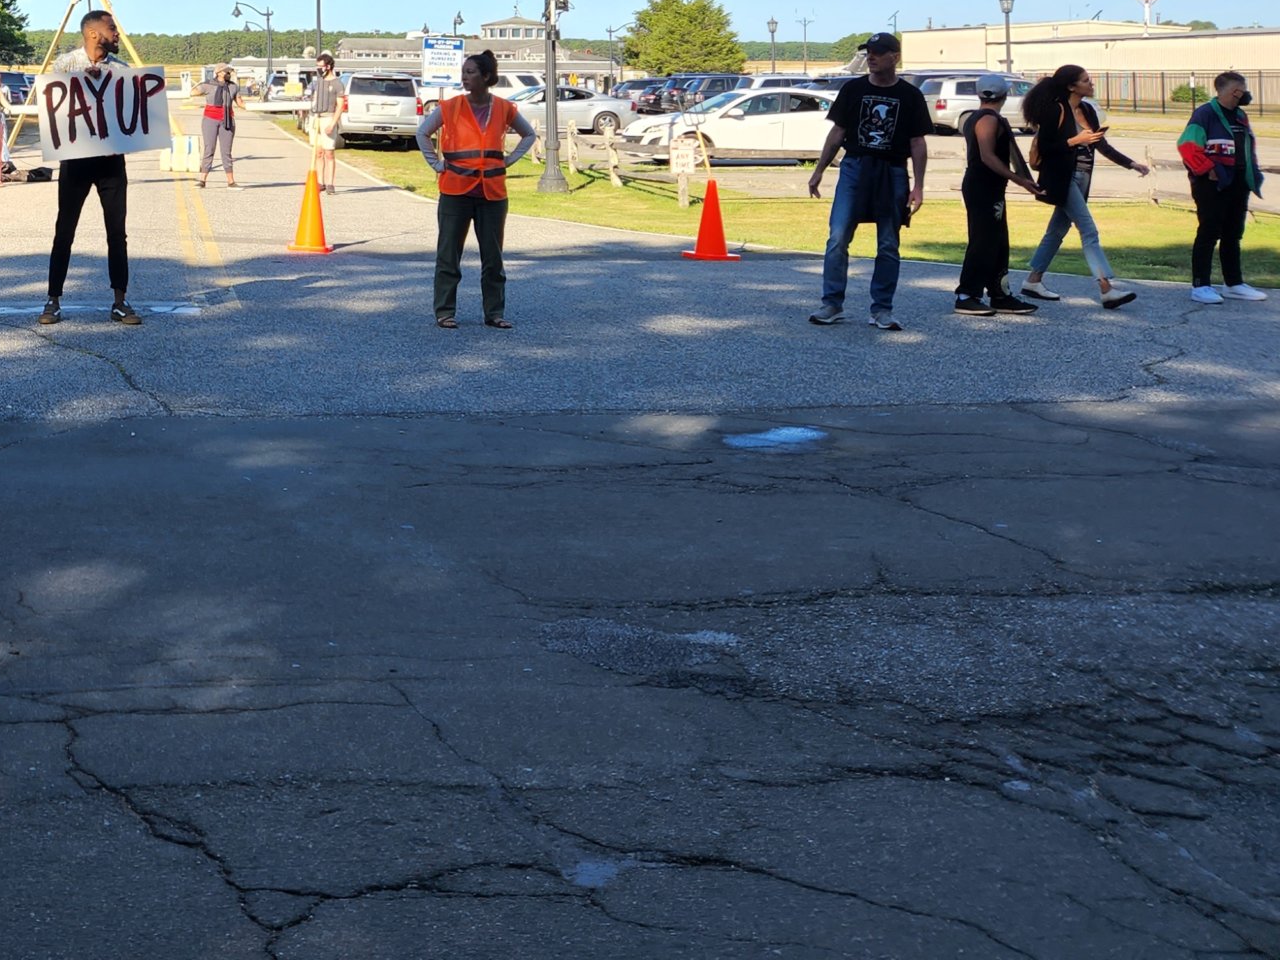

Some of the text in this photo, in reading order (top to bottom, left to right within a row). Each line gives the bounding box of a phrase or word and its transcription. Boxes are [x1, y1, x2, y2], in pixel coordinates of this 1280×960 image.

[42, 70, 165, 150] PAY UP
[675, 152, 689, 160] ANY
